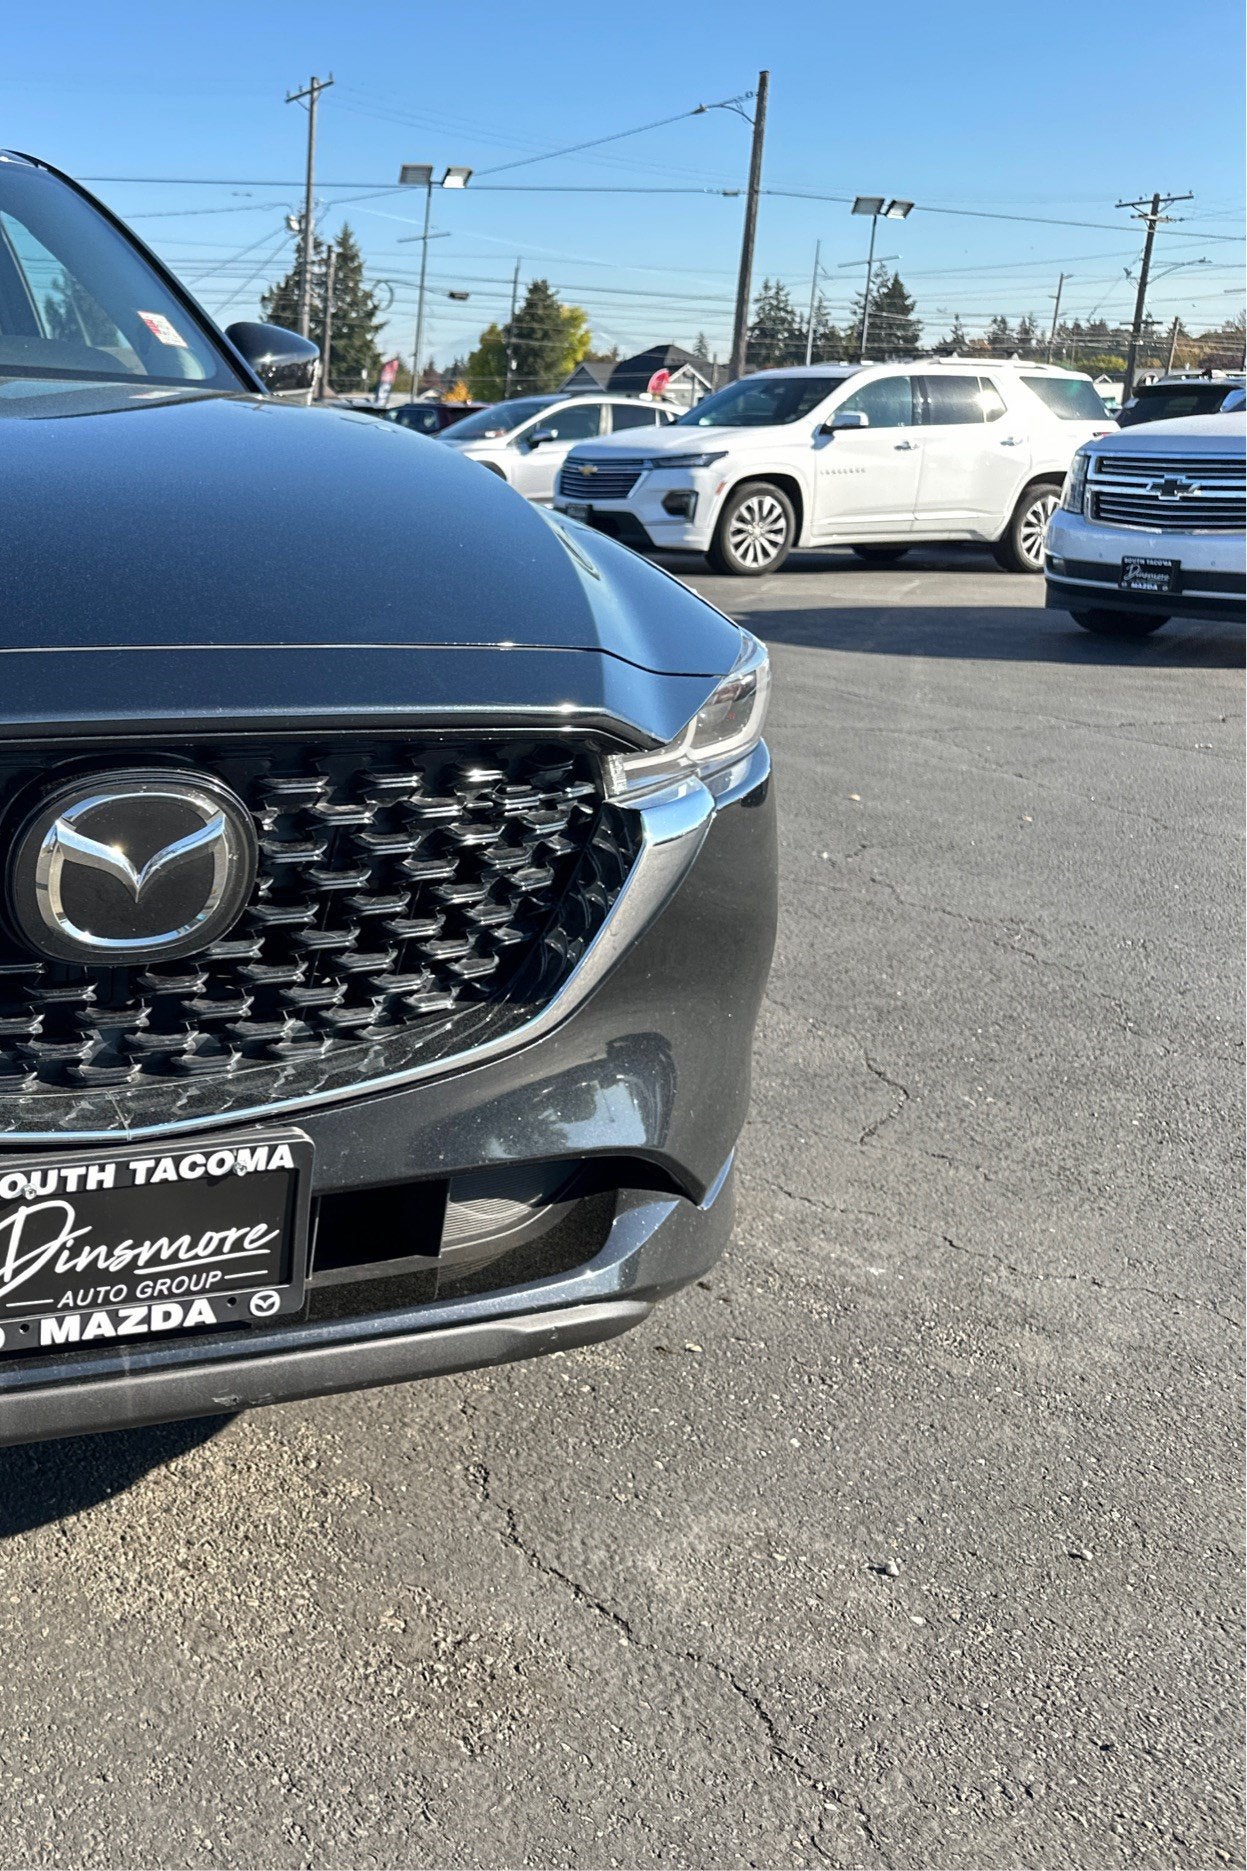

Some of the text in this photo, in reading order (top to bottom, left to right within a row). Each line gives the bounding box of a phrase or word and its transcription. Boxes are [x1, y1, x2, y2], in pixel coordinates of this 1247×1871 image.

[129, 1144, 295, 1184] TACOMA
[57, 1270, 223, 1308] AUTO GROUP
[39, 1298, 217, 1346] MAZDA
